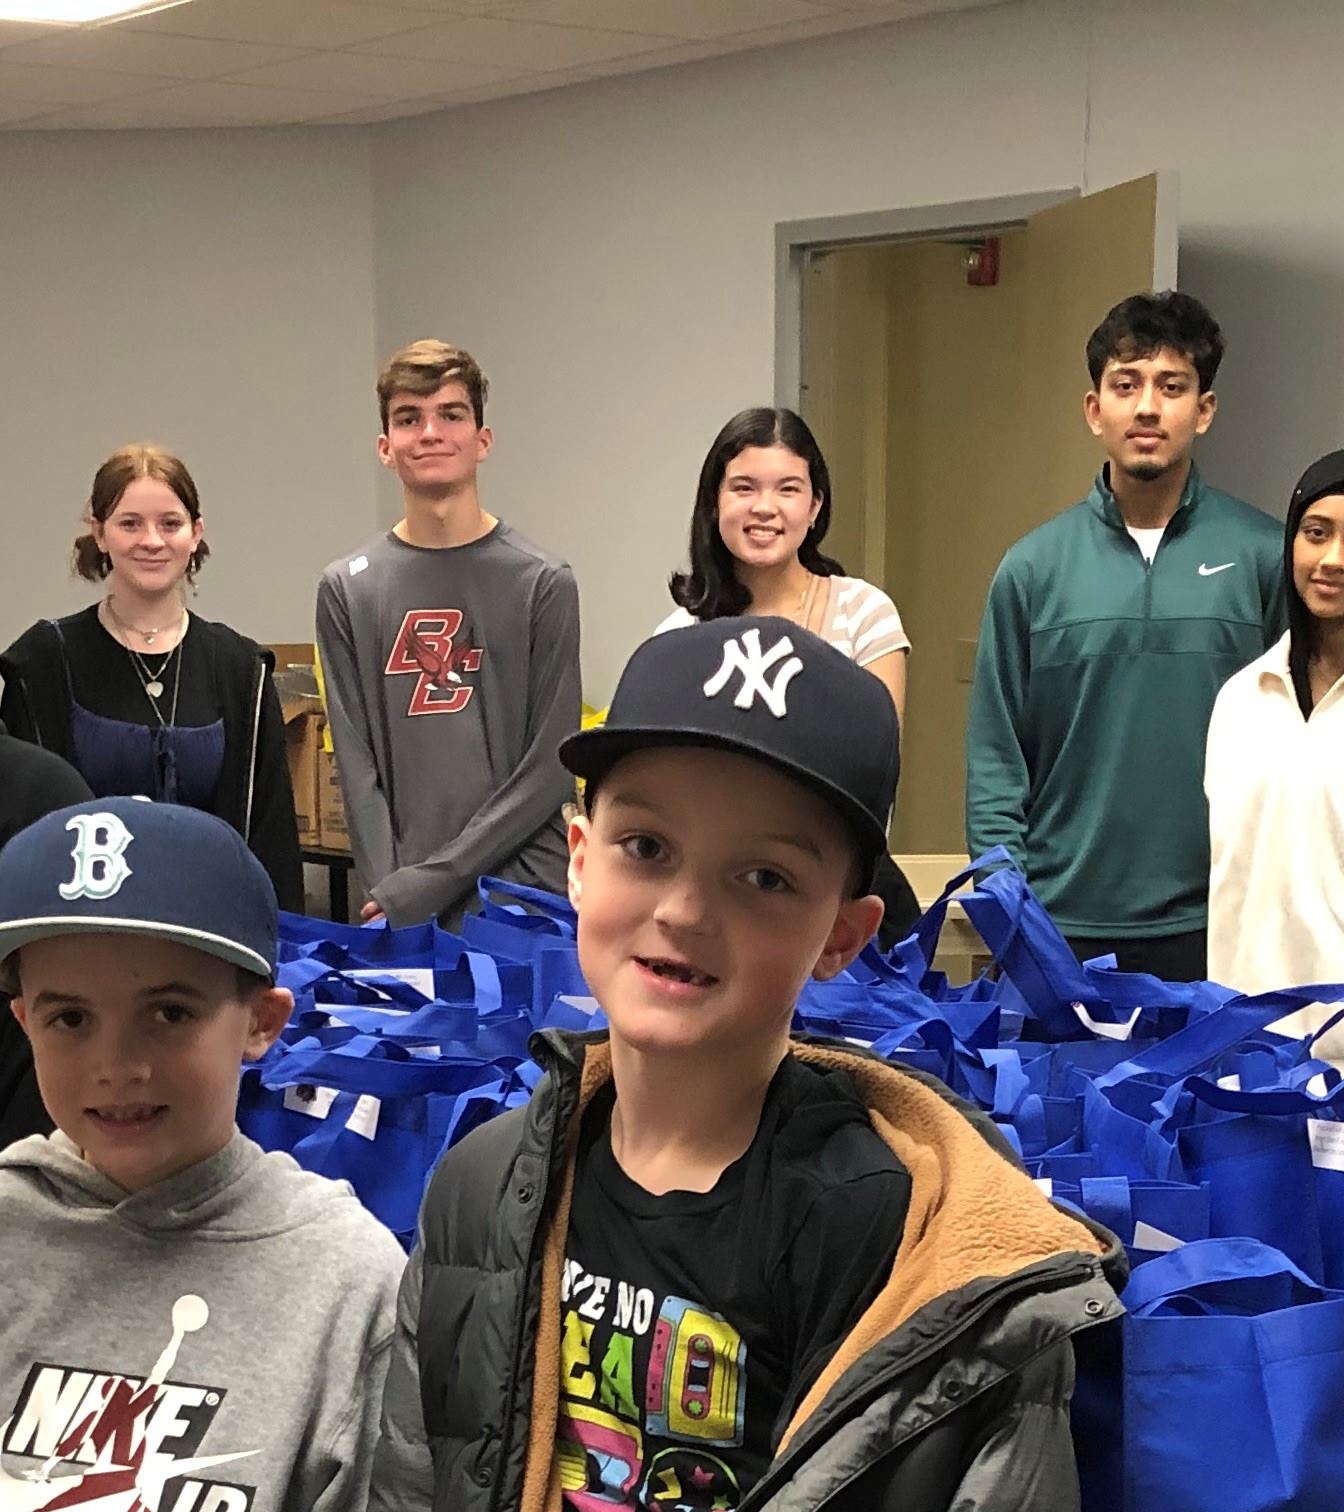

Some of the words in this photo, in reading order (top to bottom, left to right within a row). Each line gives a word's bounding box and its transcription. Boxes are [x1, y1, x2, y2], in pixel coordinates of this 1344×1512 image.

[59, 812, 134, 900] B
[612, 1281, 654, 1335] NO
[6, 1367, 208, 1465] NIKE
